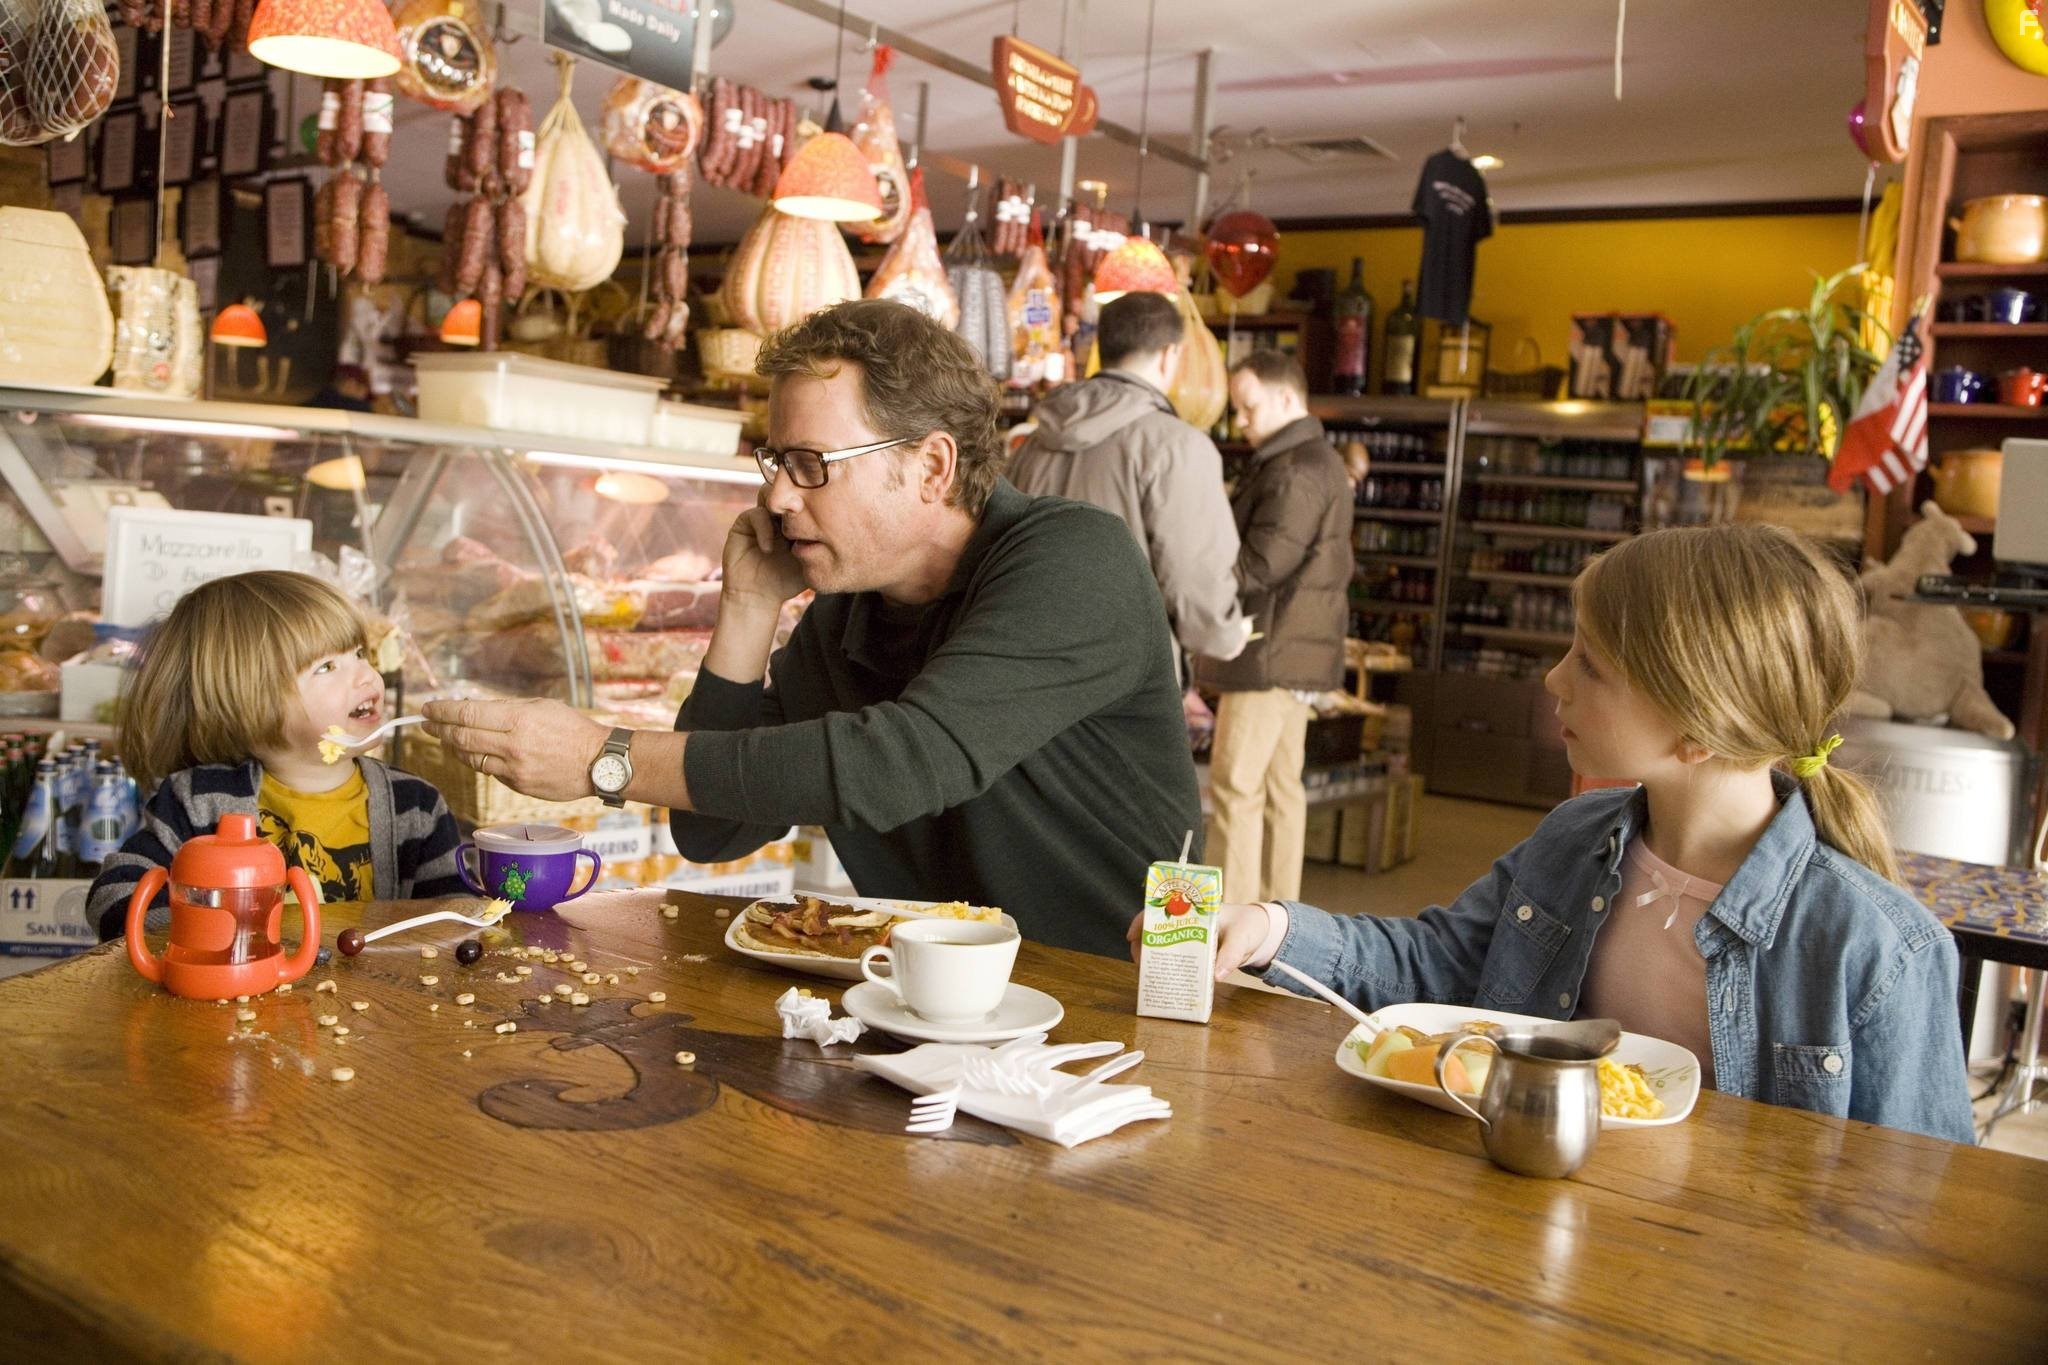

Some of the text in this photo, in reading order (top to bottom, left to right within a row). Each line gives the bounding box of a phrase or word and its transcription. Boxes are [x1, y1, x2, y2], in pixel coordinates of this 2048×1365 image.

[646, 14, 681, 43] Daily
[1879, 765, 1964, 794] OTTLES
[26, 921, 58, 936] SAN
[1154, 917, 1200, 931] 100% JUICE
[1146, 928, 1204, 945] ORGANICS
